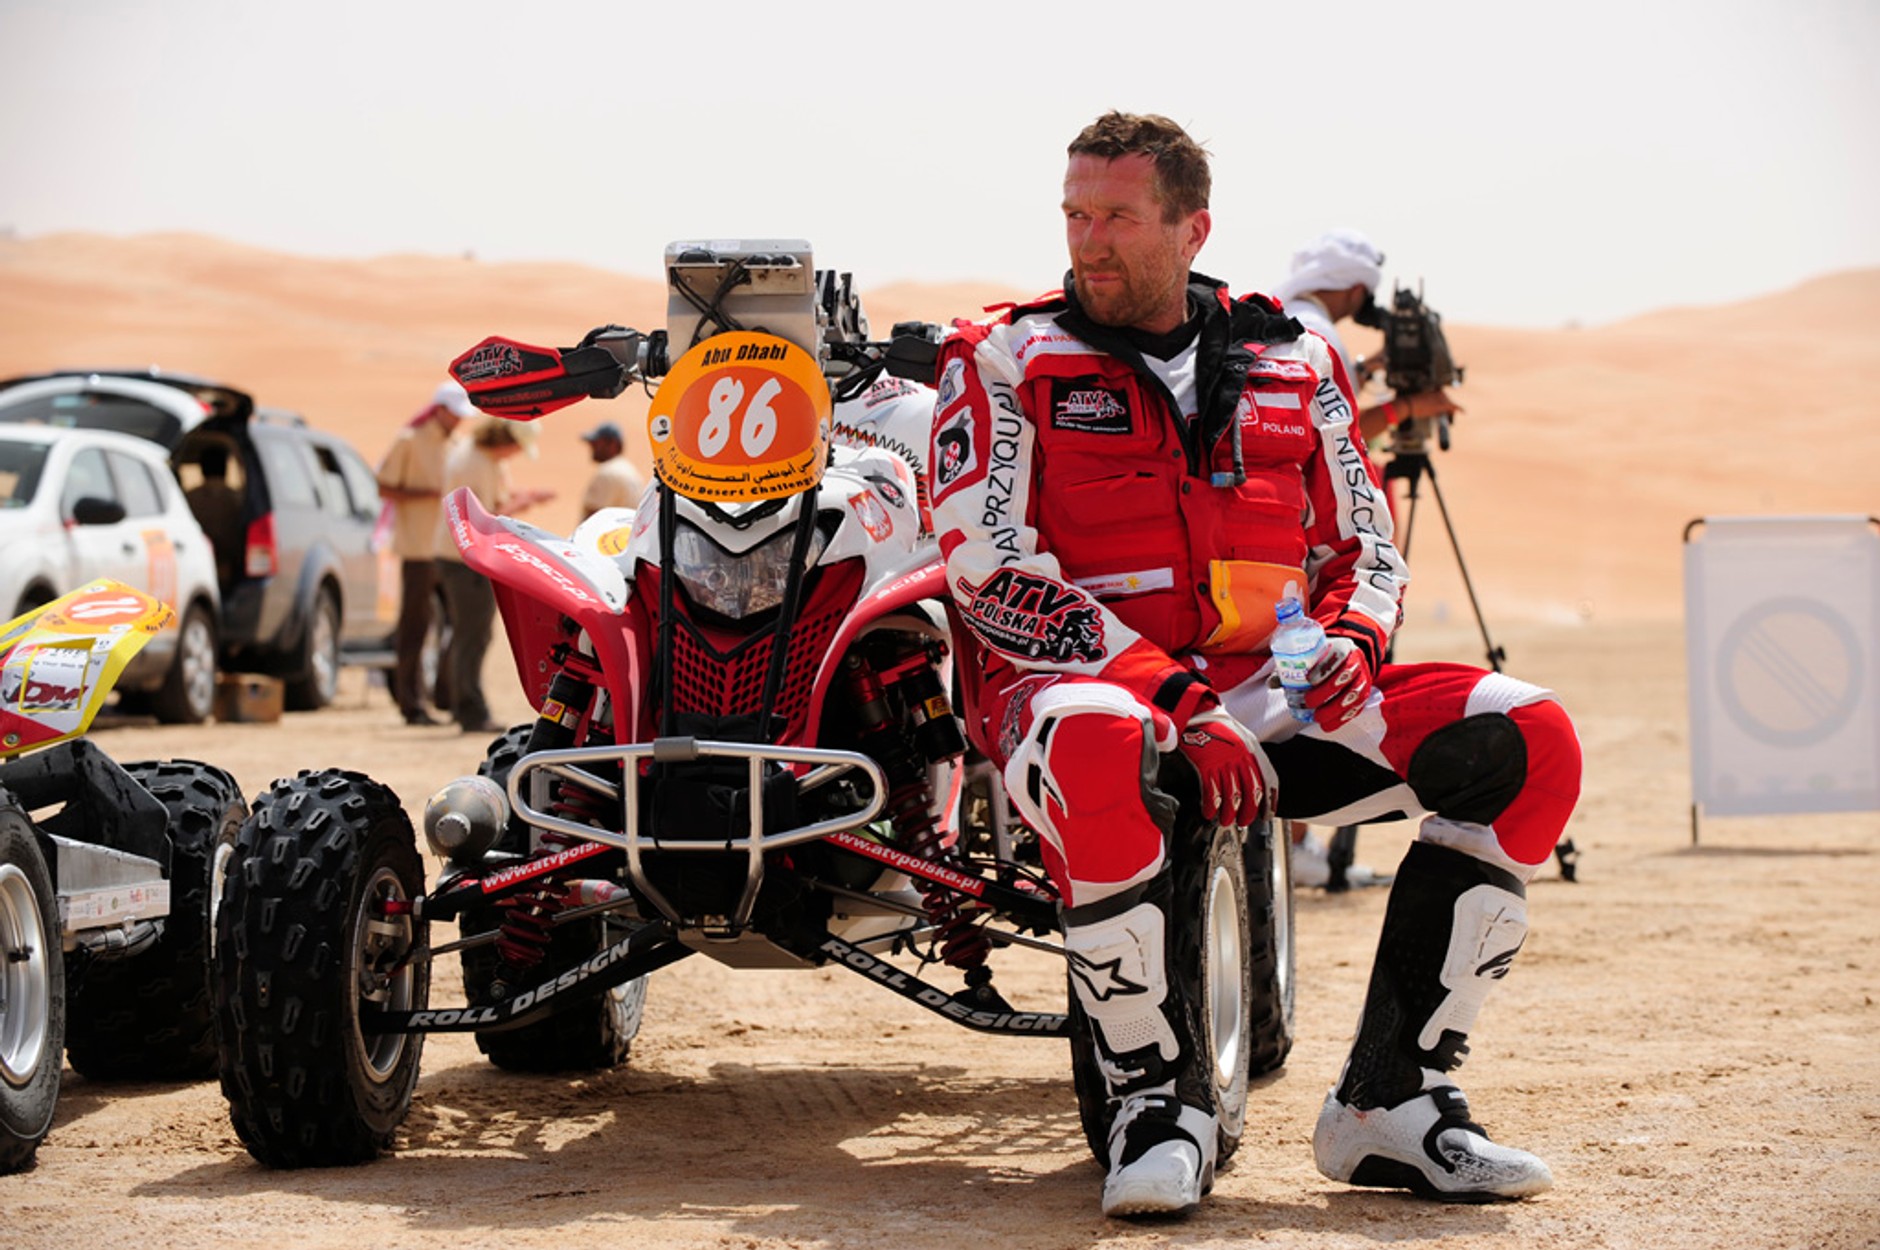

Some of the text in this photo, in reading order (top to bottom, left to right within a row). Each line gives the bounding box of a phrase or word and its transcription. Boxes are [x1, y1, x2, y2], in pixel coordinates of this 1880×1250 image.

[701, 343, 788, 367] Abu Dhabi
[697, 376, 783, 458] 86
[1068, 391, 1100, 405] ATV
[1315, 377, 1350, 420] NIE
[1262, 423, 1305, 436] POLAND
[698, 485, 745, 497] Desert
[750, 476, 815, 496] Challenge
[978, 570, 1081, 617] ATV
[972, 599, 1039, 636] POLSKA
[408, 937, 631, 1028] ROLL DESIGN
[821, 939, 1067, 1032] ROLL DESIGN
